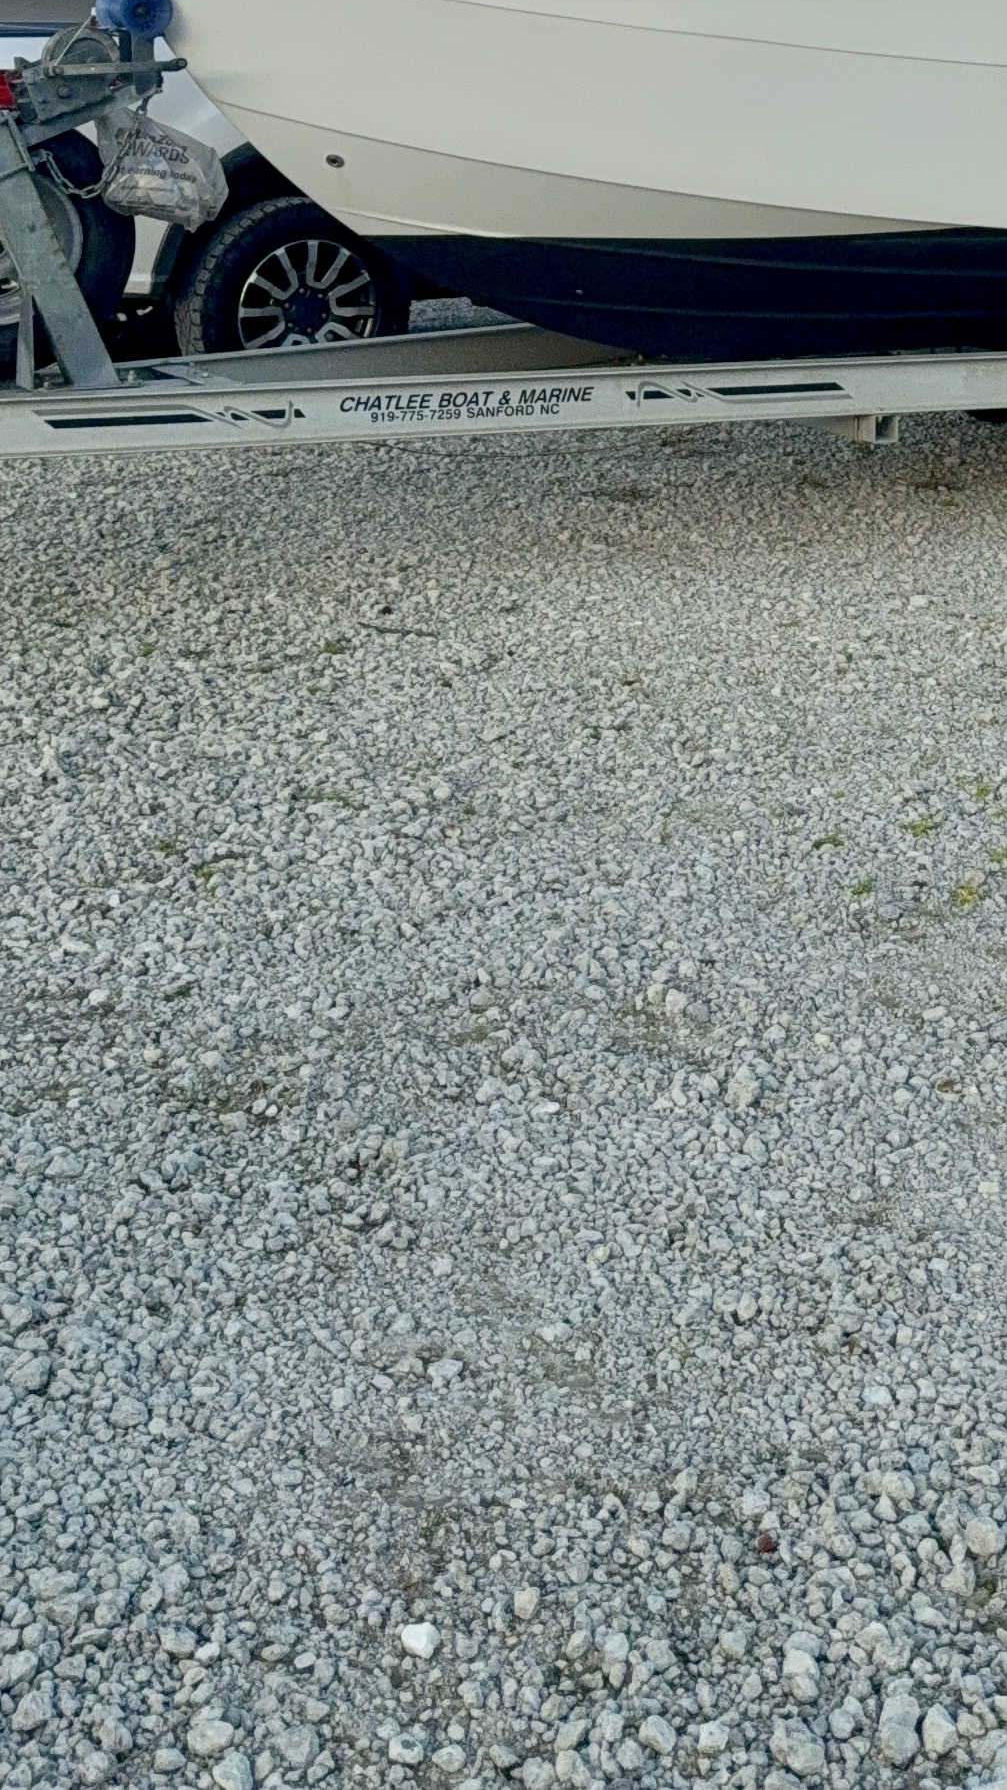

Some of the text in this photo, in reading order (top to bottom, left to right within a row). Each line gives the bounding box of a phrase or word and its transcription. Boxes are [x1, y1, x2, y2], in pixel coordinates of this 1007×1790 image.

[127, 165, 168, 180] earning
[169, 169, 198, 185] today
[340, 386, 595, 413] CHATLEE BOAT & MARINE
[371, 403, 560, 423] 919-775-7259 SANFORD NC
